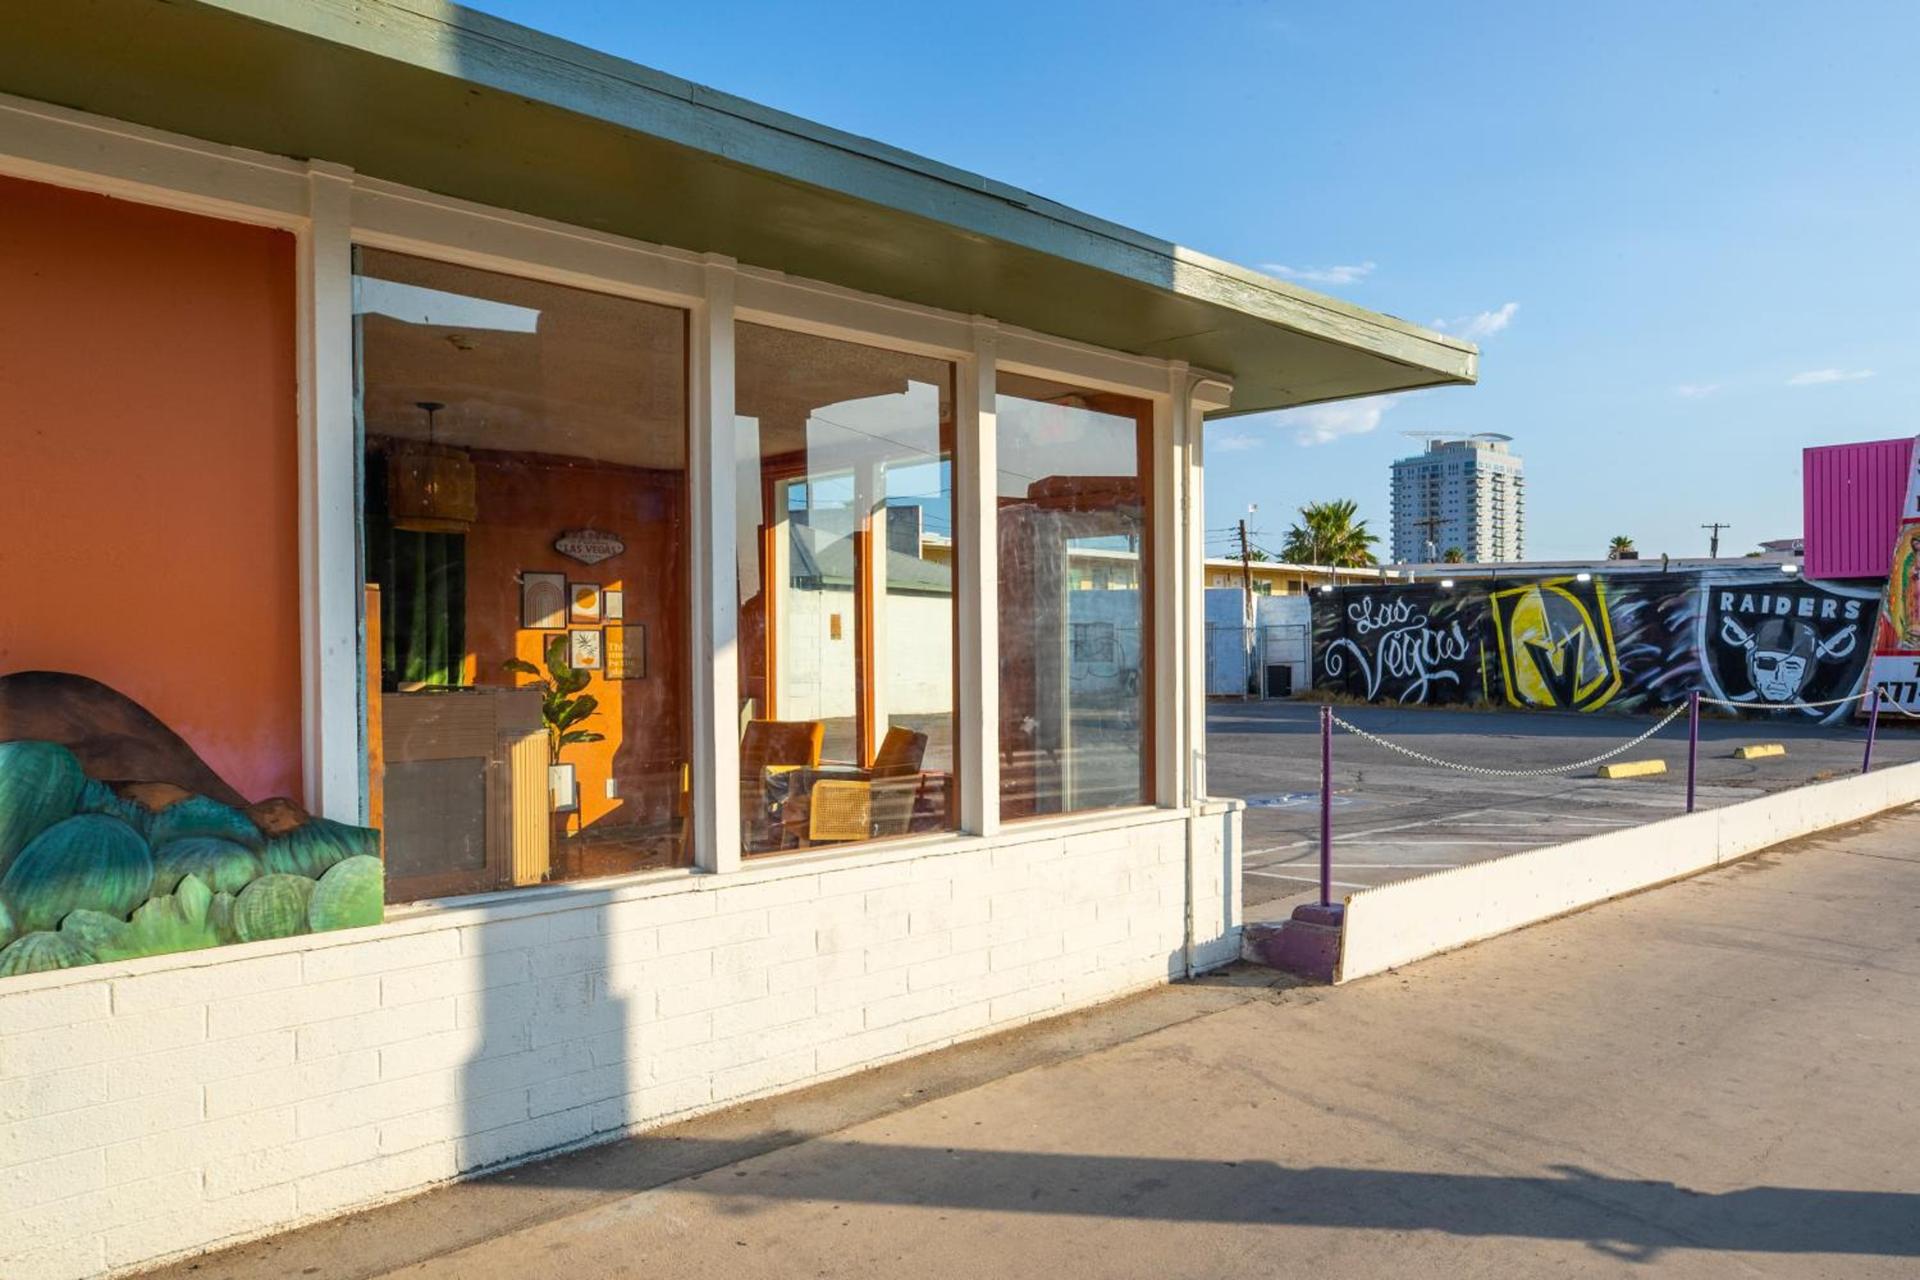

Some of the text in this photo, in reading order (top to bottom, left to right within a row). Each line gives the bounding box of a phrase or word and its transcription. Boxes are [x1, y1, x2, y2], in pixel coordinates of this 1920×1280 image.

[564, 544, 616, 554] LAS VEGAS
[1348, 595, 1417, 635] Las
[1719, 591, 1863, 620] RAIDERS
[1325, 615, 1470, 705] Vegas
